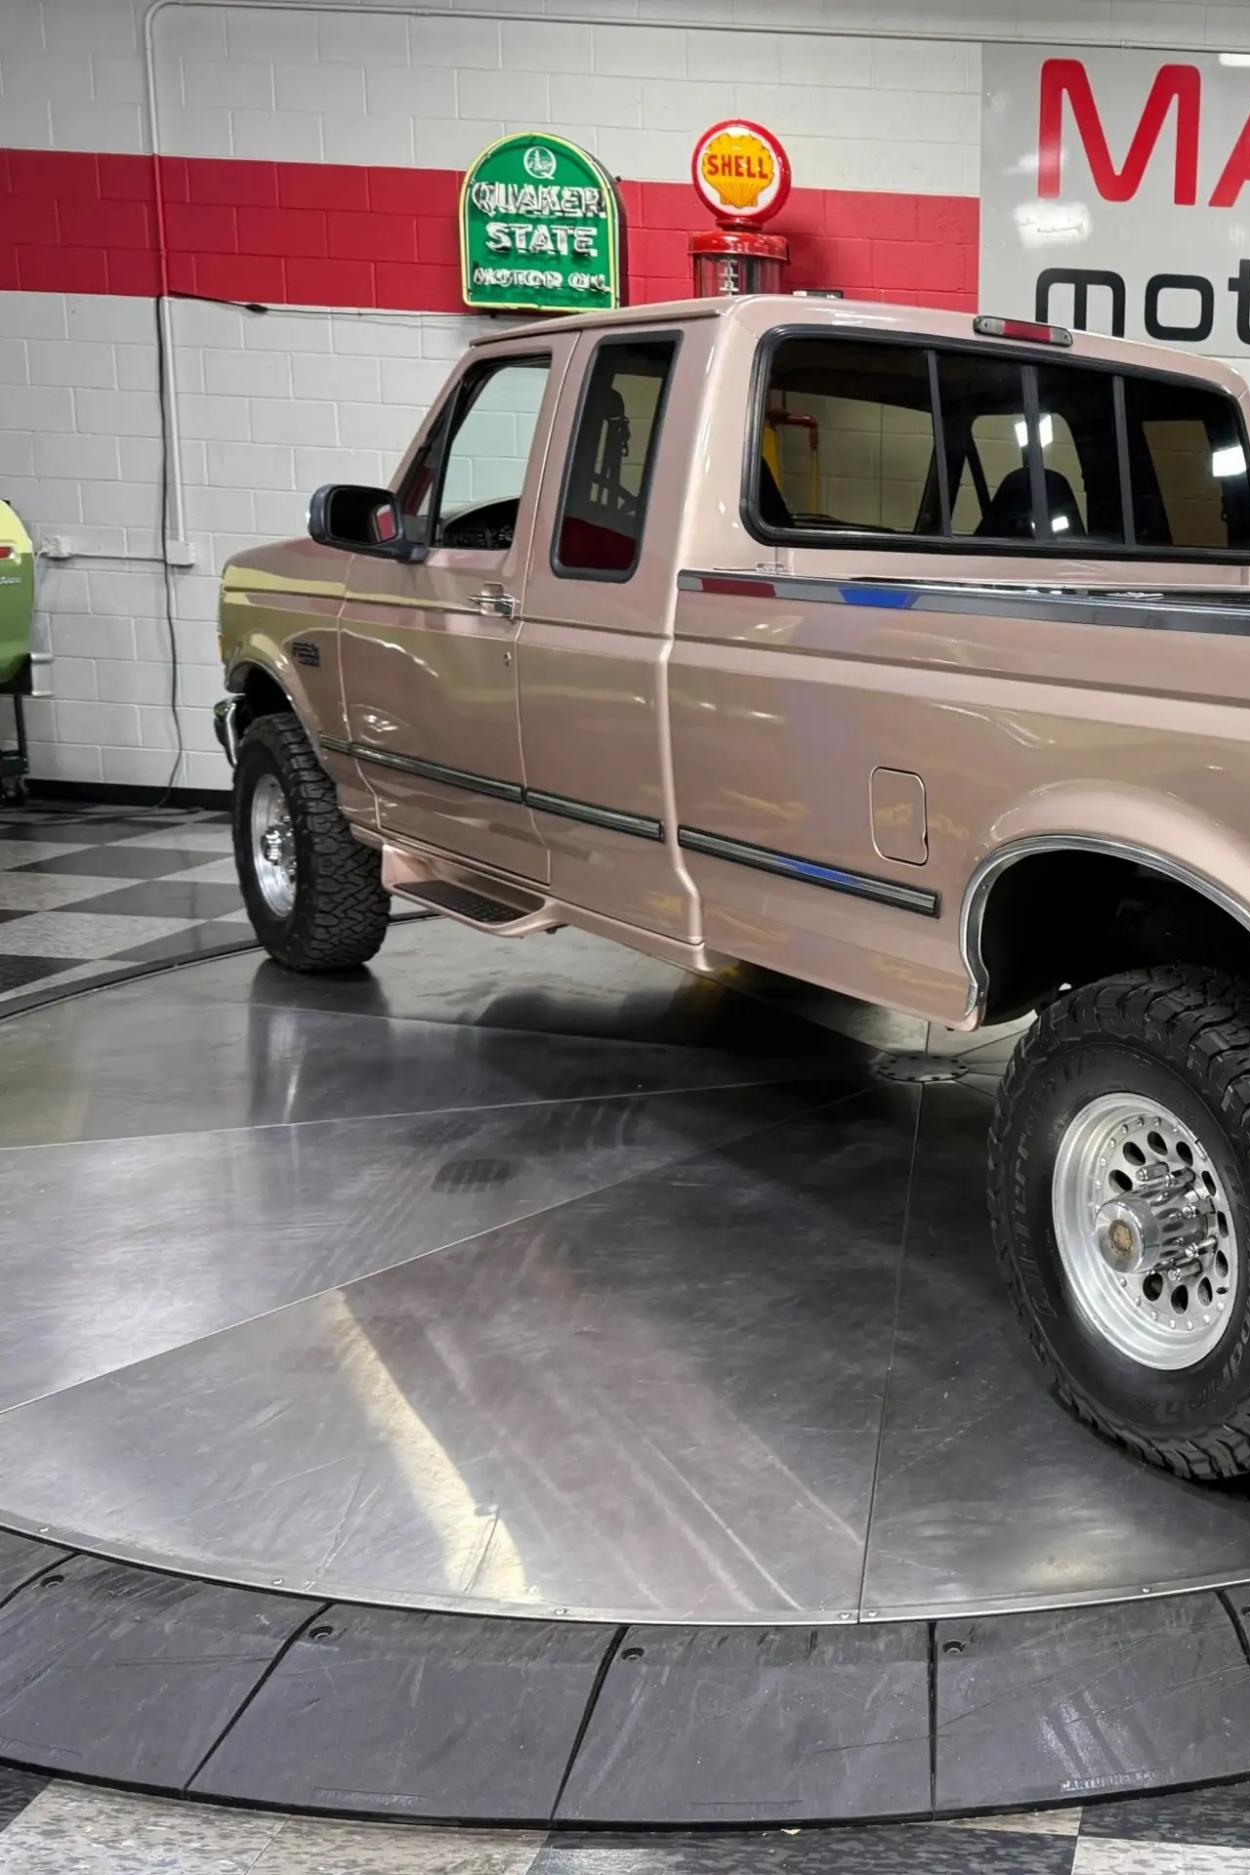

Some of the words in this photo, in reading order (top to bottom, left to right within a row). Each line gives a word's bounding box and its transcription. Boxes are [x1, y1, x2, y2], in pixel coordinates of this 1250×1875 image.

[707, 154, 769, 180] SHELL
[472, 181, 606, 218] QUAKER
[486, 221, 598, 257] STATE
[474, 267, 563, 288] MOTOR
[567, 271, 612, 293] OIL
